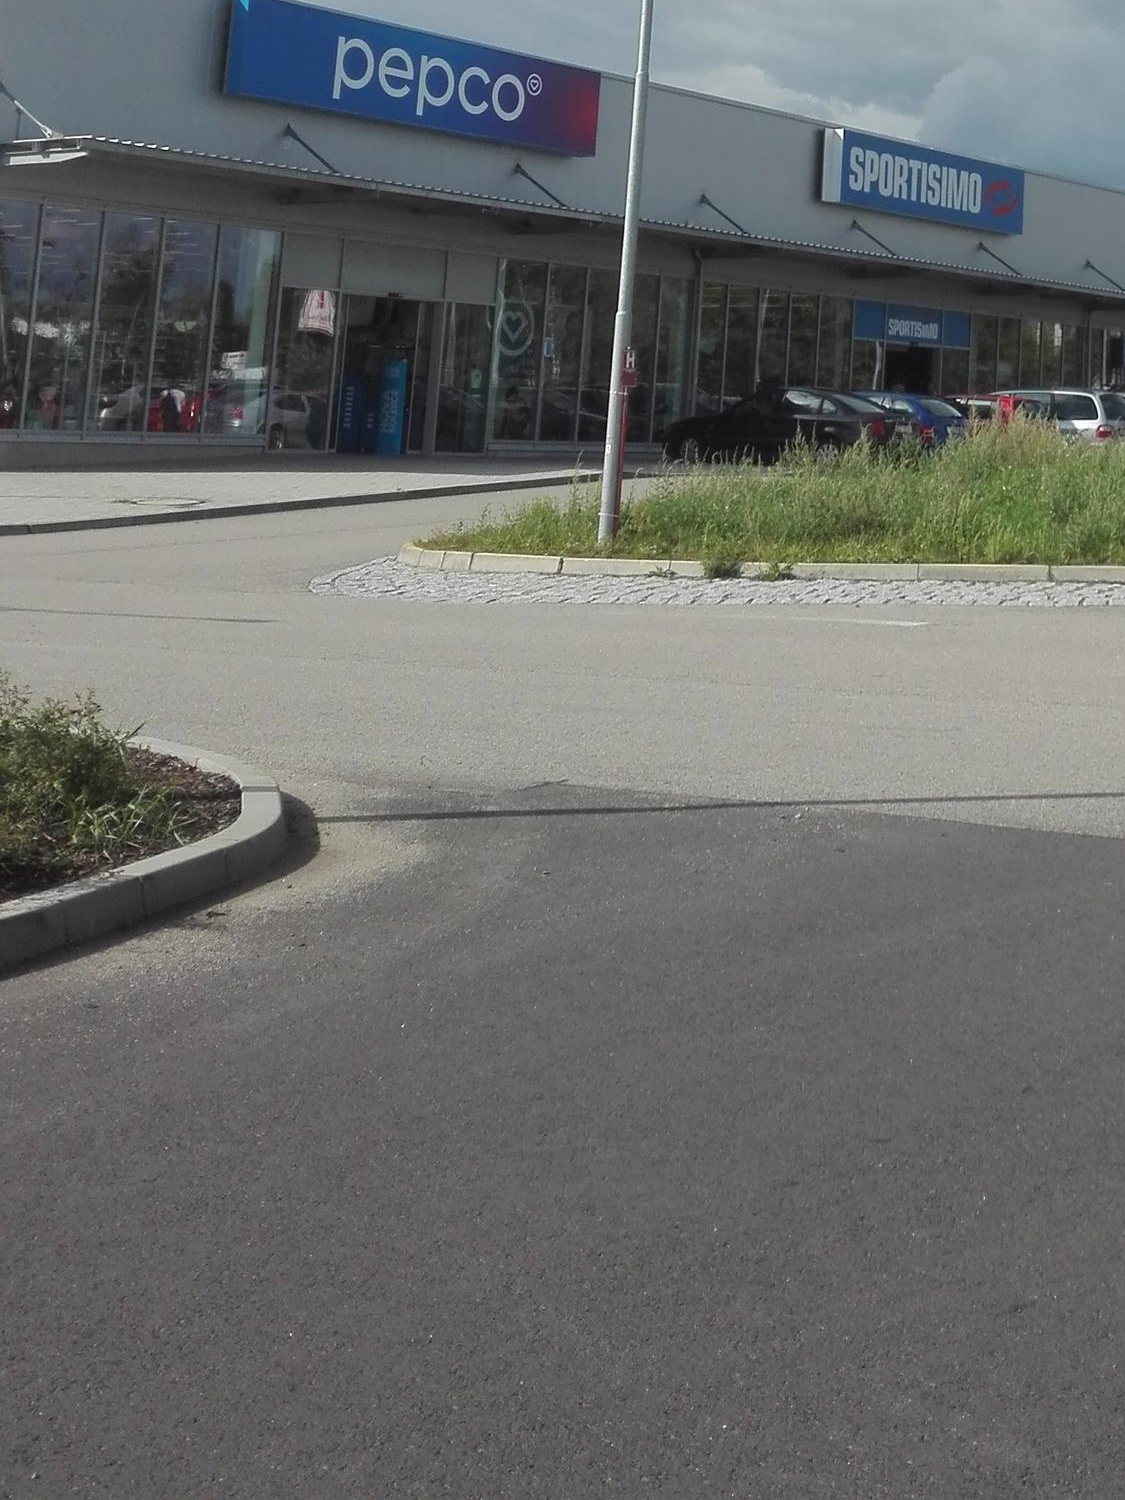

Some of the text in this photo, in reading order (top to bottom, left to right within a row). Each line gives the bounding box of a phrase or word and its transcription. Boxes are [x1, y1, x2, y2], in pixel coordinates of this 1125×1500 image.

[332, 35, 526, 122] pepco
[848, 146, 983, 214] SPORTISIMO
[888, 318, 939, 340] SPORTISIMO
